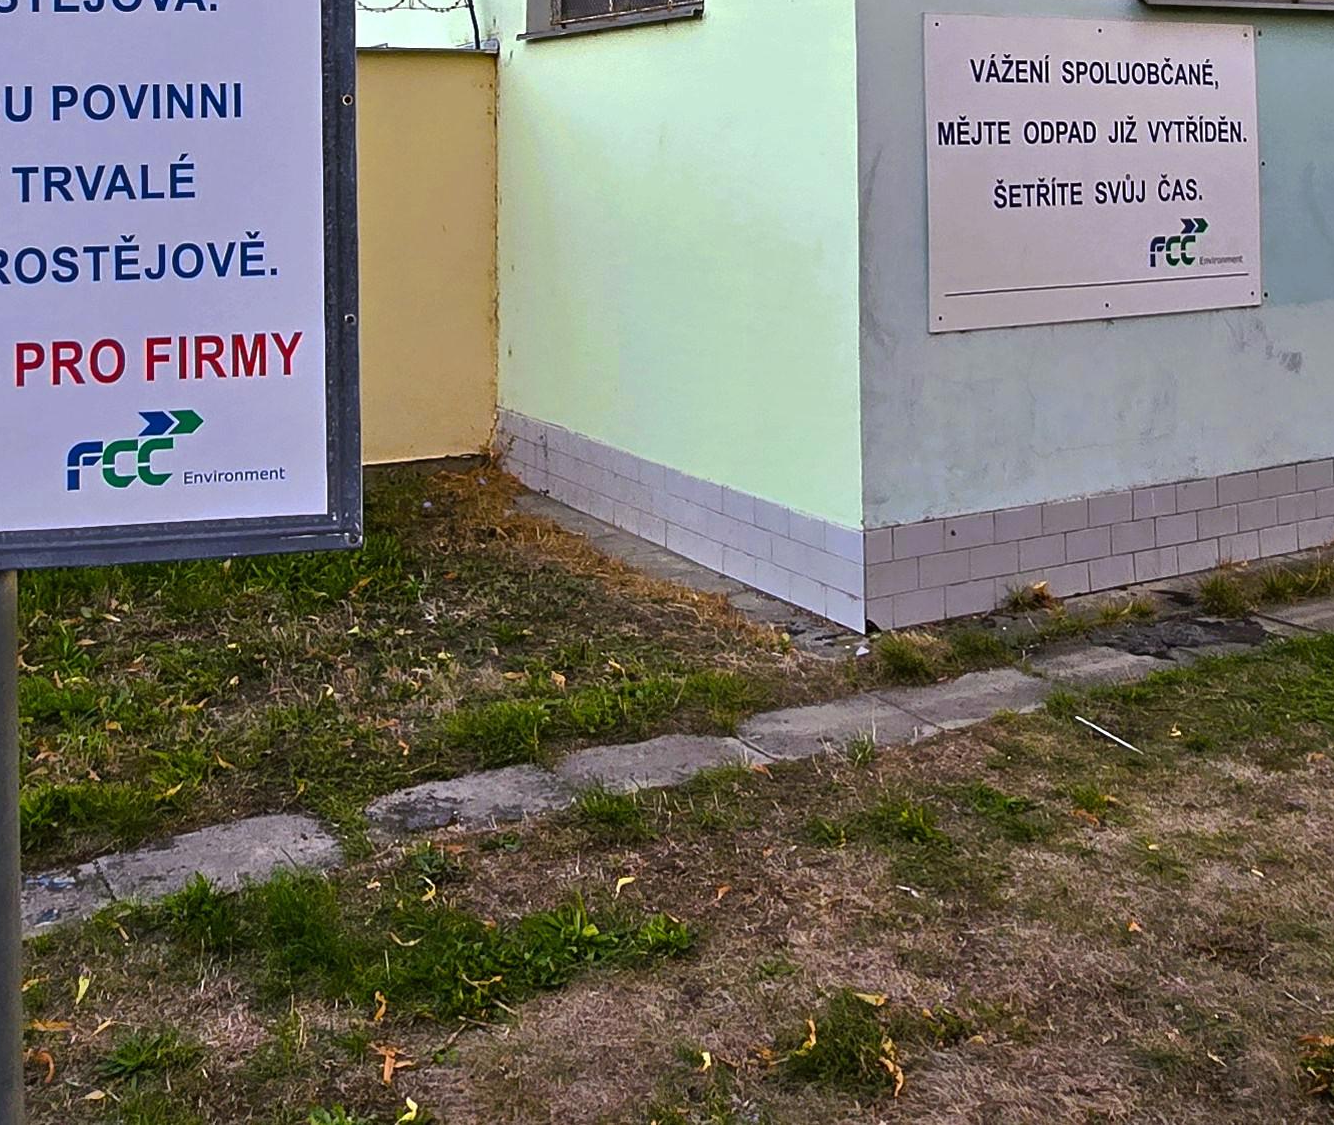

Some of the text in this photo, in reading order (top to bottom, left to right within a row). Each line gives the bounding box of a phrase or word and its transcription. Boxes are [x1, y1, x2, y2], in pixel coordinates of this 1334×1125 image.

[969, 53, 1219, 90] VÁŽENÍ SPOLUOBČANÉ,
[52, 82, 242, 121] POVINNI
[937, 115, 1248, 146] MĚJTE ODPAD JIŽ VYTŘÍDĚN.
[11, 153, 196, 203] TRVALÉ
[993, 173, 1203, 209] ŠETŘÍTE SVŮJ ČAS.
[1149, 235, 1244, 268] FCC Environment
[15, 338, 126, 388] PRO
[146, 331, 303, 382] FIRMY
[64, 437, 286, 492] FCC Environment
